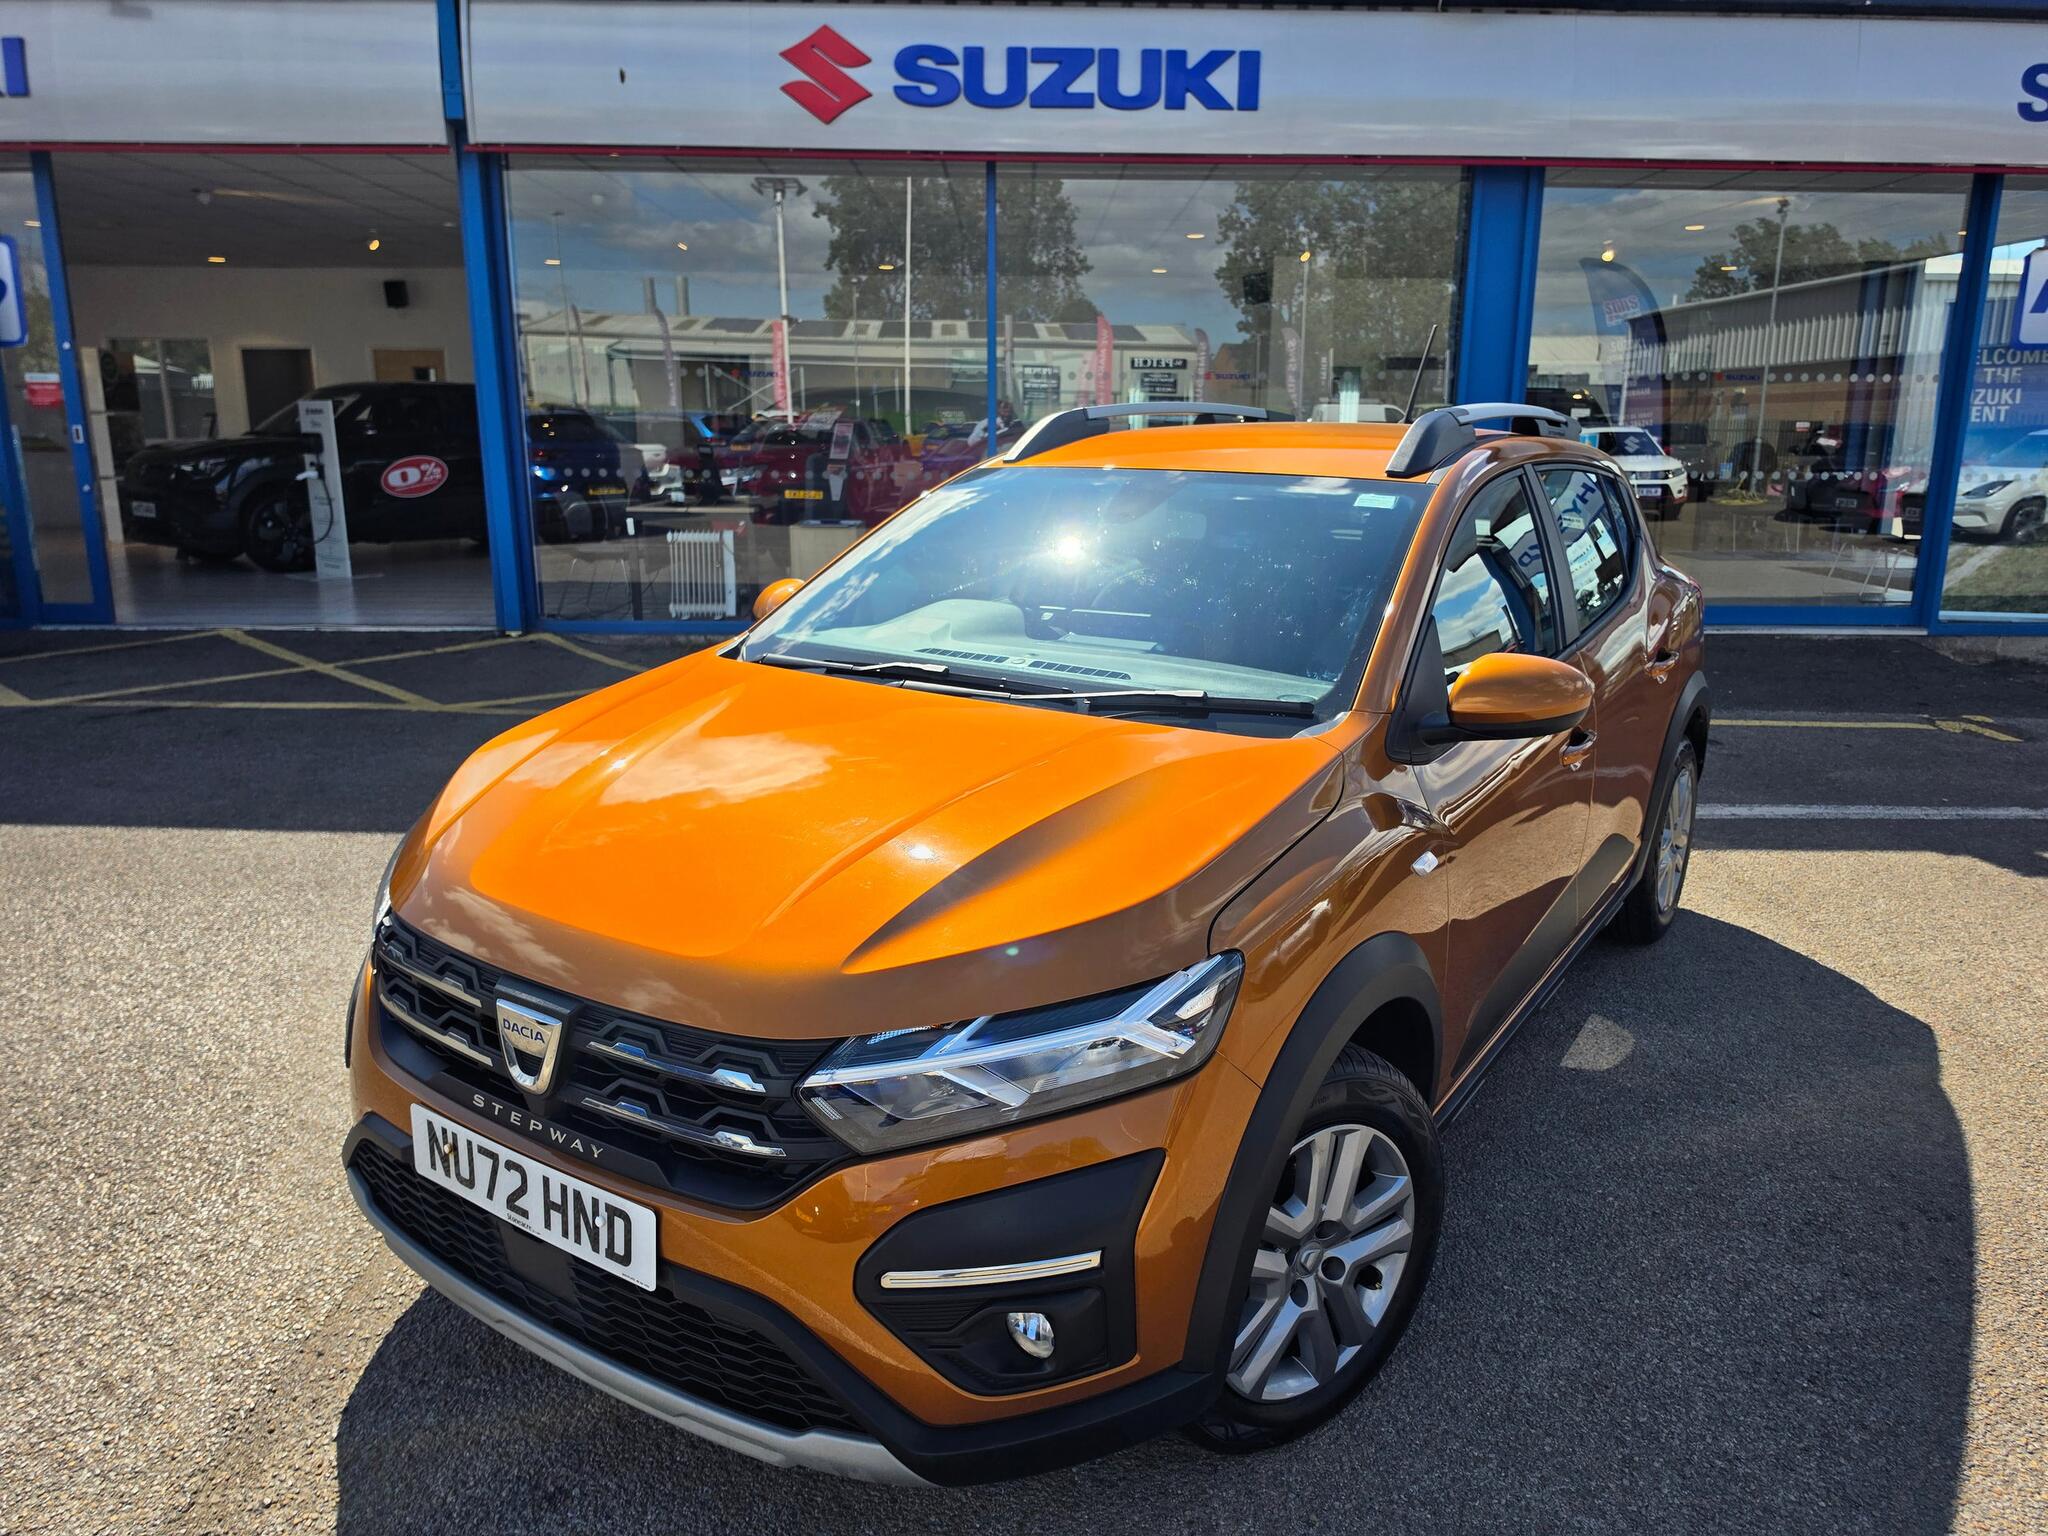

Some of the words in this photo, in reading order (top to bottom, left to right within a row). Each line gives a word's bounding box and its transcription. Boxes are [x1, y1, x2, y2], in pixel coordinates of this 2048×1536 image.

[893, 44, 1261, 111] SUZUKI
[1970, 387, 2022, 405] ZUKI
[1983, 367, 2023, 384] THE
[502, 1018, 545, 1044] DACIA
[472, 1093, 604, 1159] STEPWAY
[426, 1118, 530, 1220] NU72
[542, 1174, 632, 1268] HND
